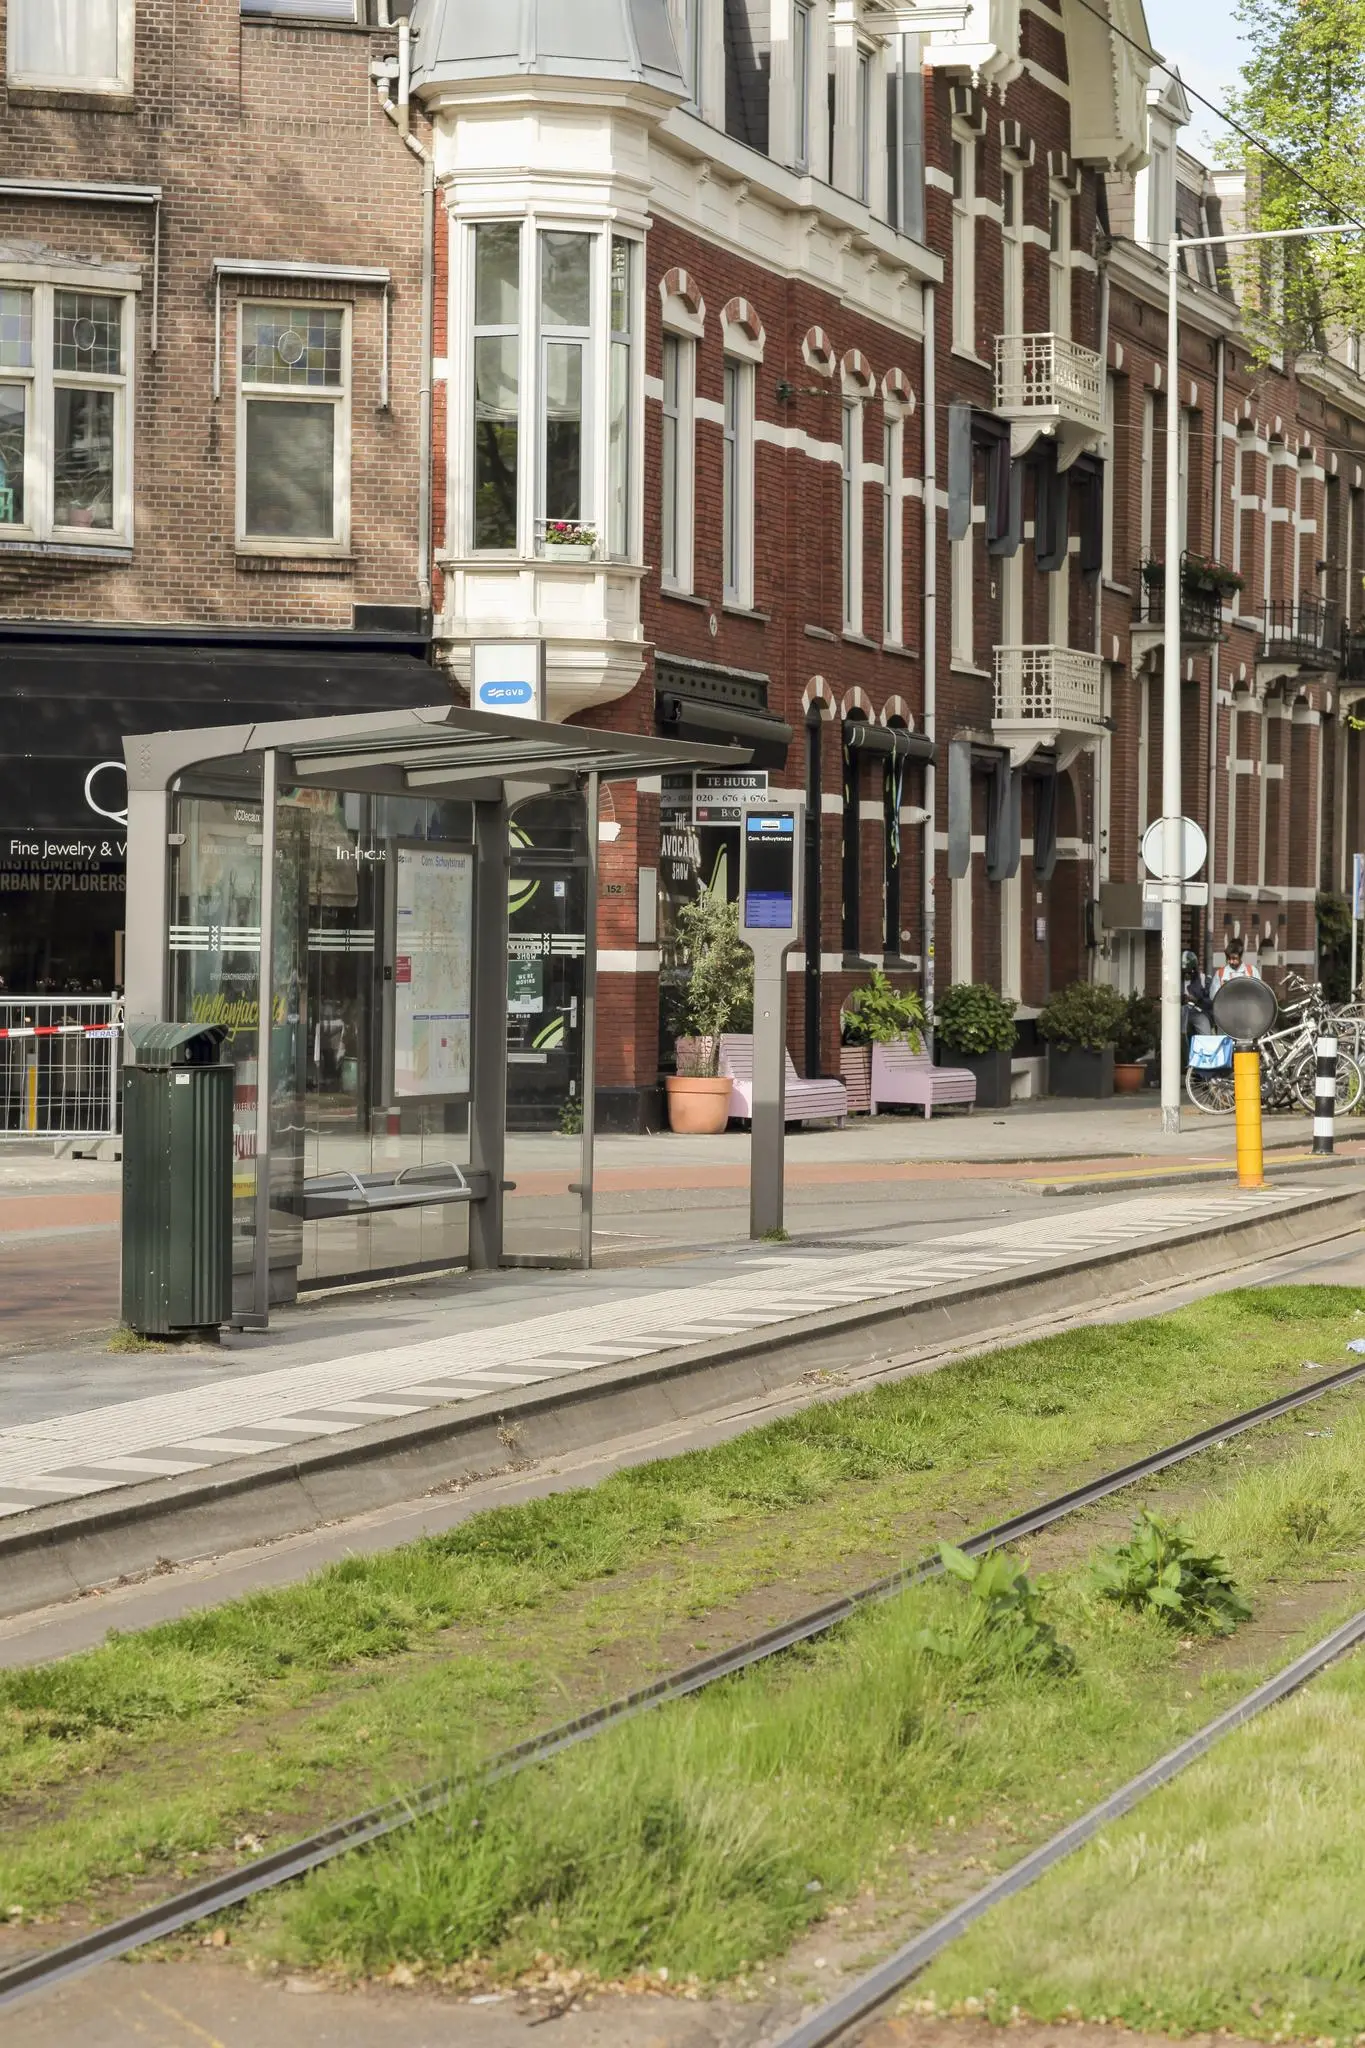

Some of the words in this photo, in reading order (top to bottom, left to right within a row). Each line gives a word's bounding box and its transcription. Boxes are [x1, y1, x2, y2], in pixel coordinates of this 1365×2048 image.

[707, 777, 721, 787] TE
[723, 777, 757, 787] HUUR
[696, 794, 713, 802] 020
[722, 794, 738, 802] 676
[750, 794, 766, 802] 676
[234, 809, 261, 823] JCDecaux
[675, 812, 687, 831] THE
[10, 840, 39, 855] Fine
[42, 840, 97, 860] Jewelry
[100, 841, 113, 856] &
[672, 862, 688, 880] SHOW
[44, 874, 127, 892] EXPLORERS
[607, 885, 622, 893] 152
[88, 1030, 119, 1038] HERAS
